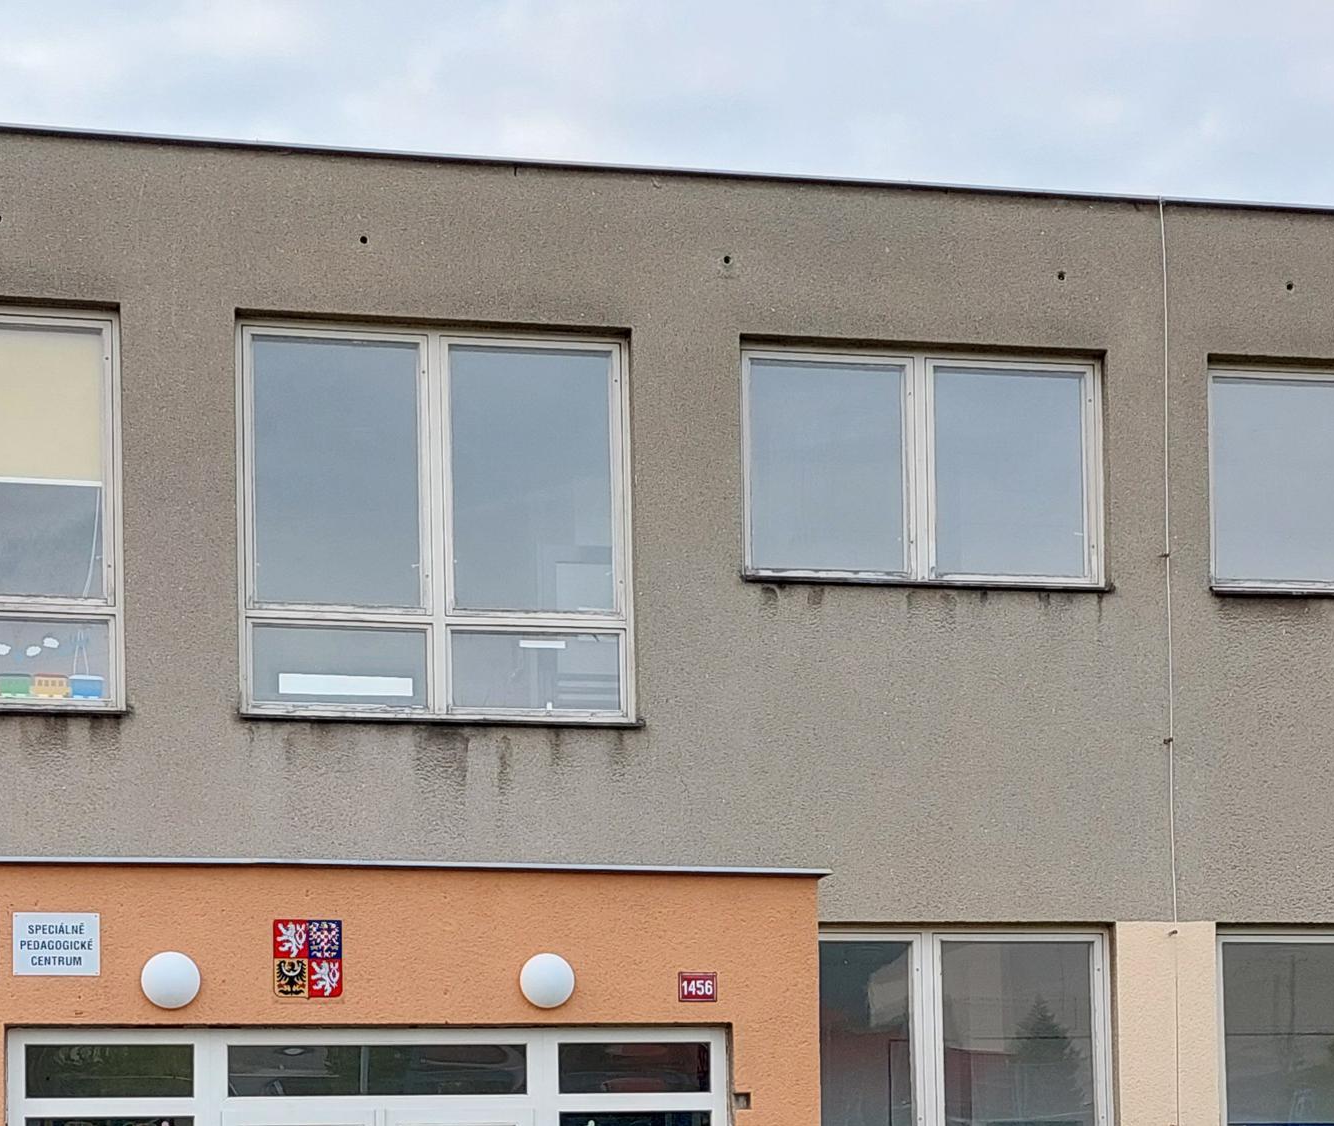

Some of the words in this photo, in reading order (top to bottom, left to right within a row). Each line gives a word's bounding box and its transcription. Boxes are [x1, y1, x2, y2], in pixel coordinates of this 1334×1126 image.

[27, 922, 85, 935] SPECIÁLNĚ
[19, 938, 93, 951] PEDAGOGICKÉ
[30, 955, 83, 966] CENTRUM
[681, 980, 713, 996] 1456
